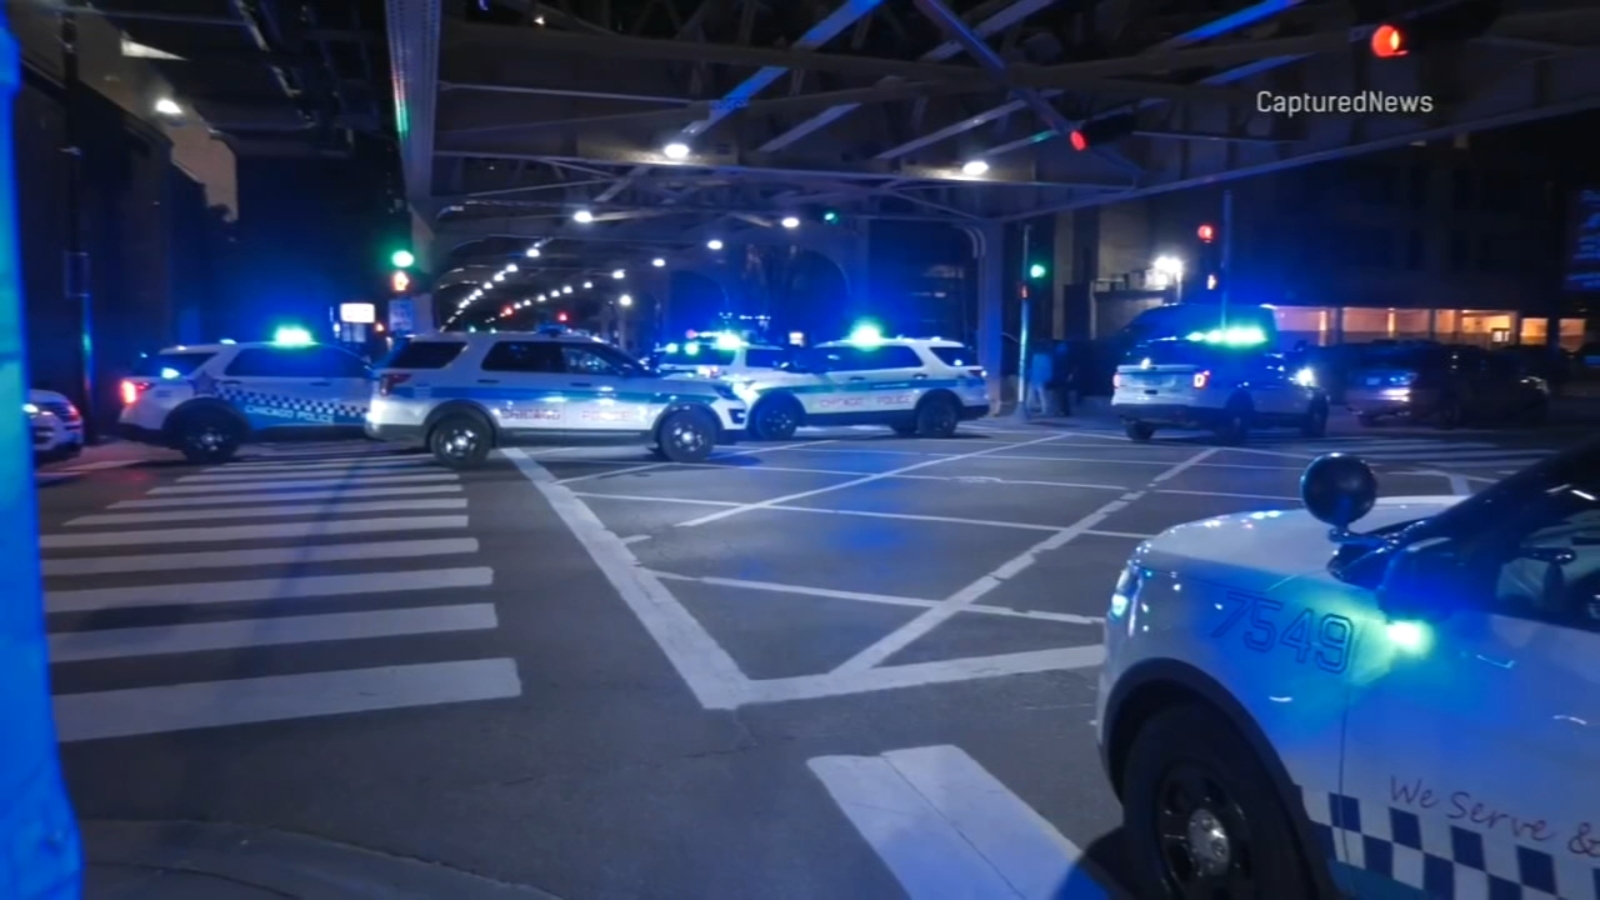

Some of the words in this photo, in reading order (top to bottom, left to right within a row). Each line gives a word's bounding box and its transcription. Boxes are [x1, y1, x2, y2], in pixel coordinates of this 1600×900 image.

[877, 393, 912, 405] POLICE
[244, 404, 295, 418] CHICAGO
[296, 410, 335, 423] POLICE
[501, 408, 561, 420] CHICAGO
[1210, 590, 1355, 675] 7549
[1390, 774, 1440, 809] We
[1446, 791, 1558, 842] Serve
